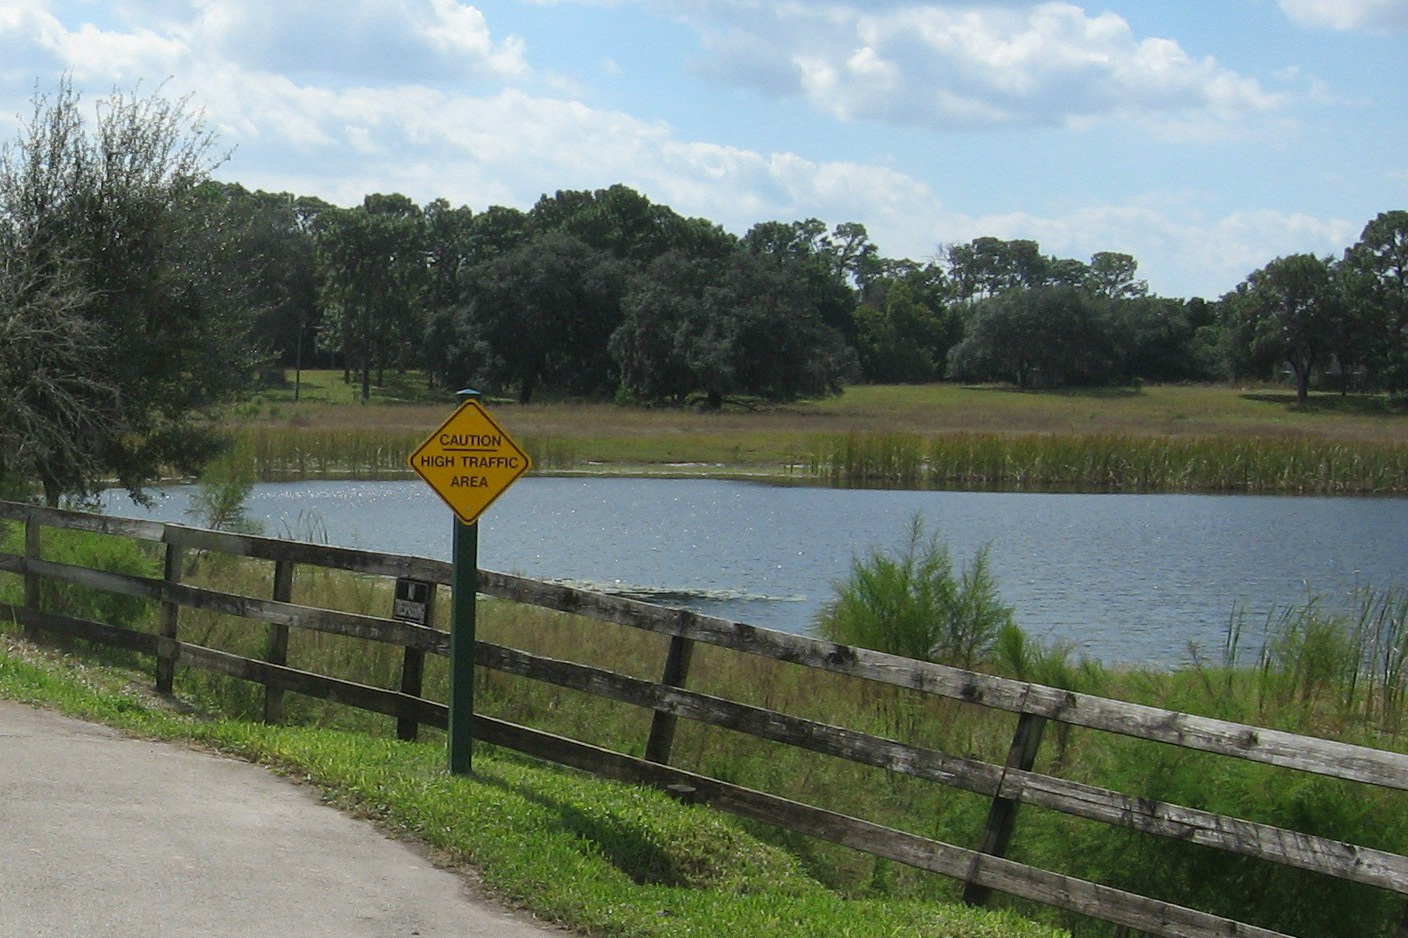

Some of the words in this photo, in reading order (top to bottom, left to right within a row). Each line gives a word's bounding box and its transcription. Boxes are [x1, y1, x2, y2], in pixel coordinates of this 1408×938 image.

[439, 434, 502, 447] CAUTION
[420, 455, 455, 468] HIGH
[461, 456, 519, 469] TRAFFIC
[450, 476, 489, 488] AREA
